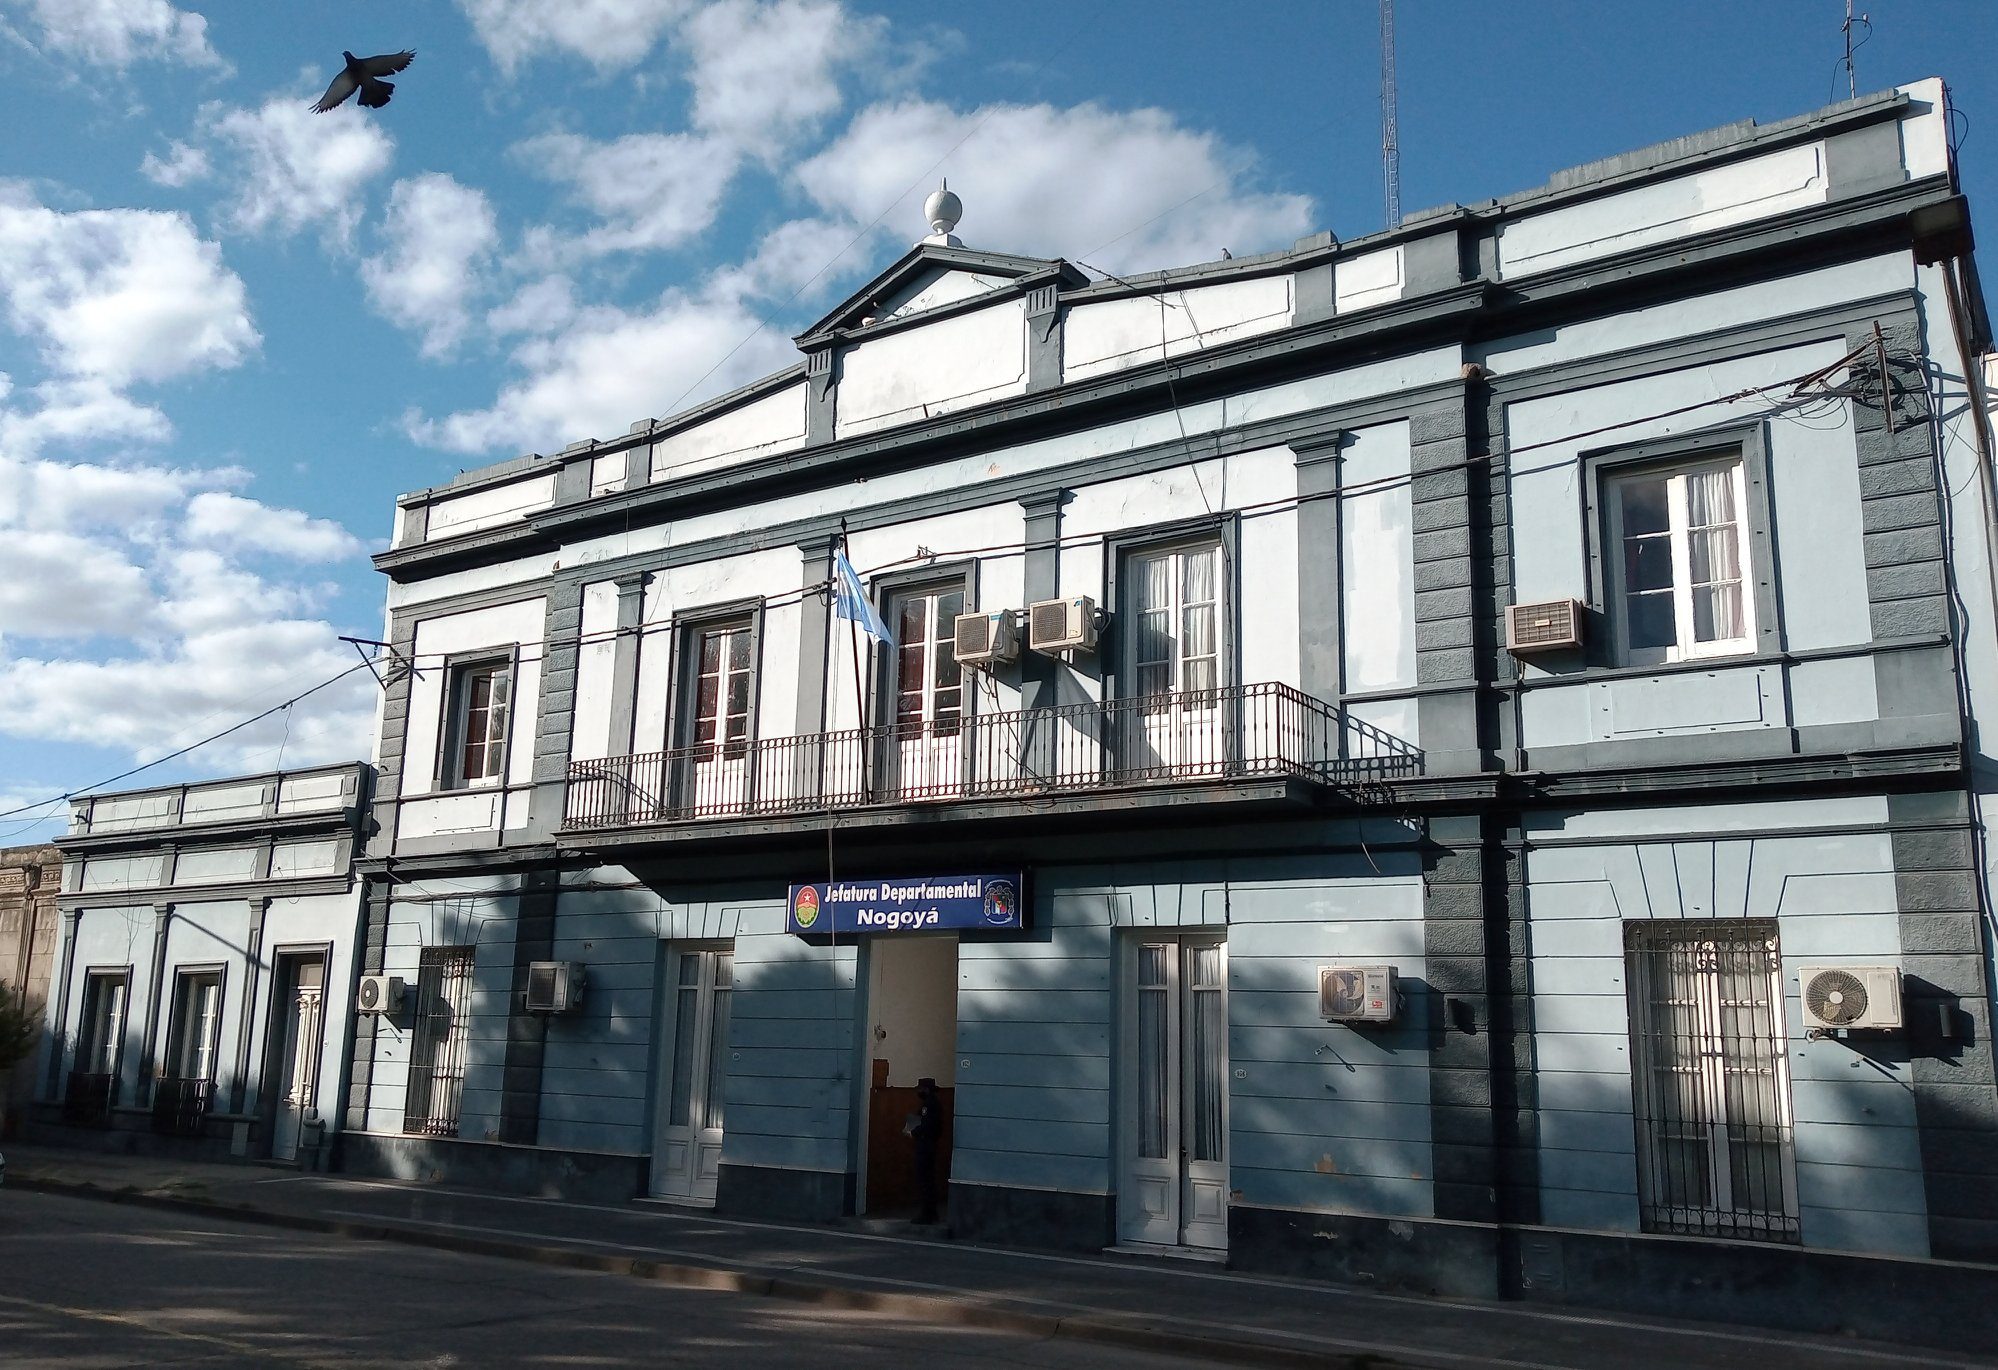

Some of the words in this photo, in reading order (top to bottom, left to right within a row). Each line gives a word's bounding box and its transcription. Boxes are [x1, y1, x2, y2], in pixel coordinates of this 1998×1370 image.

[824, 884, 877, 903] Jefatura
[881, 878, 982, 905] Departamental
[857, 906, 939, 930] Nogoyá
